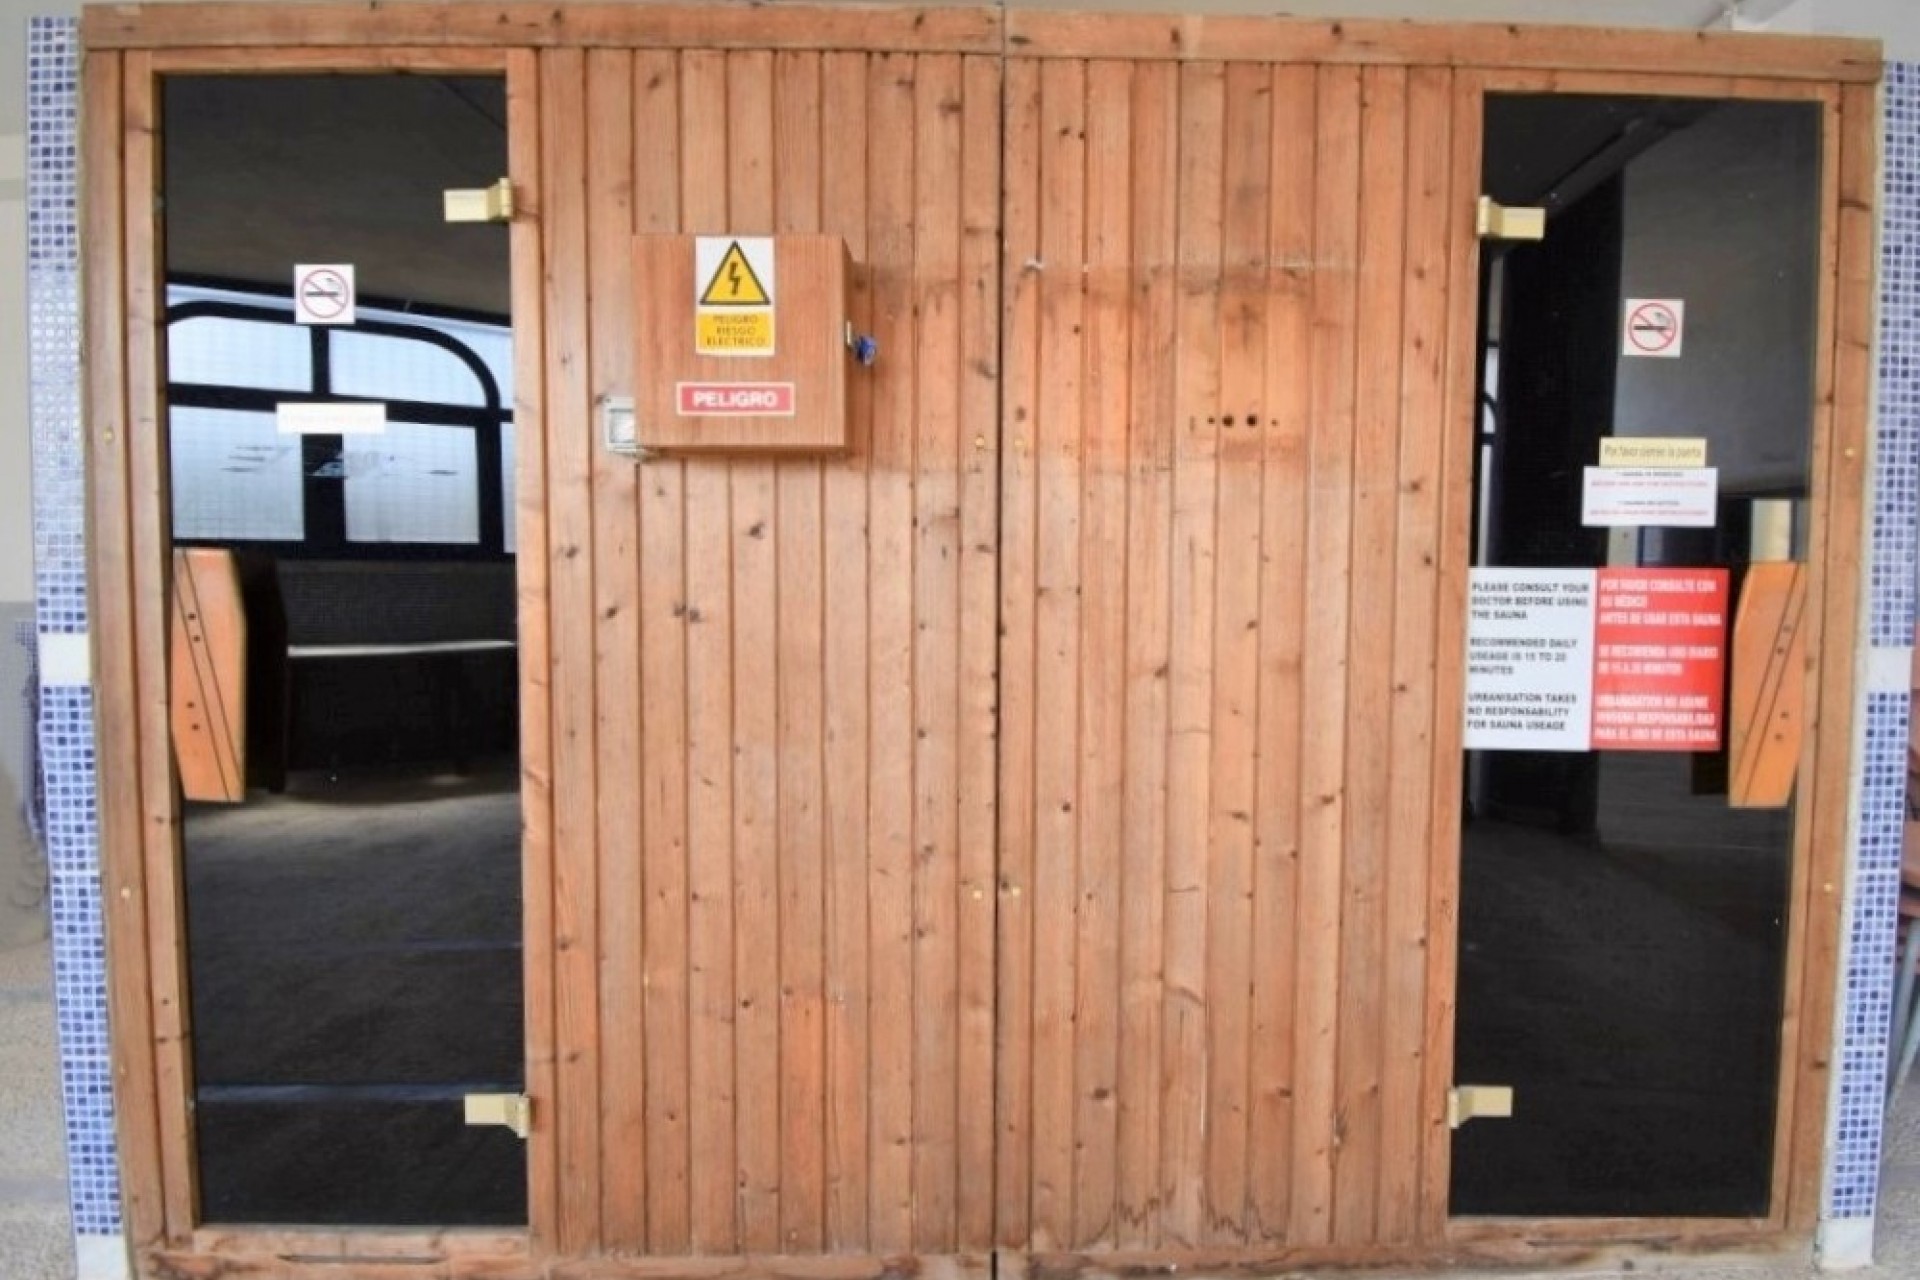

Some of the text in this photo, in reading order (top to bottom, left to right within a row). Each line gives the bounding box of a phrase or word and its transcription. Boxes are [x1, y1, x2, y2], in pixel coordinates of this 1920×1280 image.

[713, 314, 758, 324] PELIGRO
[716, 325, 756, 335] RIESGO
[692, 391, 778, 408] PELIGRO
[1472, 582, 1589, 593] PLEASE CONSULT YOUR
[1600, 579, 1618, 592] POR
[1471, 596, 1588, 607] DOCTOR BEFORE USING
[1471, 610, 1528, 620] THE SAUNA
[1692, 613, 1721, 626] SAUNA
[1470, 637, 1578, 648] RECOMMENDED DAILY
[1469, 651, 1567, 662] USEAGE IS 15 TO 20
[1469, 665, 1514, 675] MINUTES
[1468, 692, 1577, 703] URBANISATION TAKES
[1467, 706, 1569, 717] NO RESPONSABILITY
[1467, 719, 1565, 731] FOR SAUNA USEAGE
